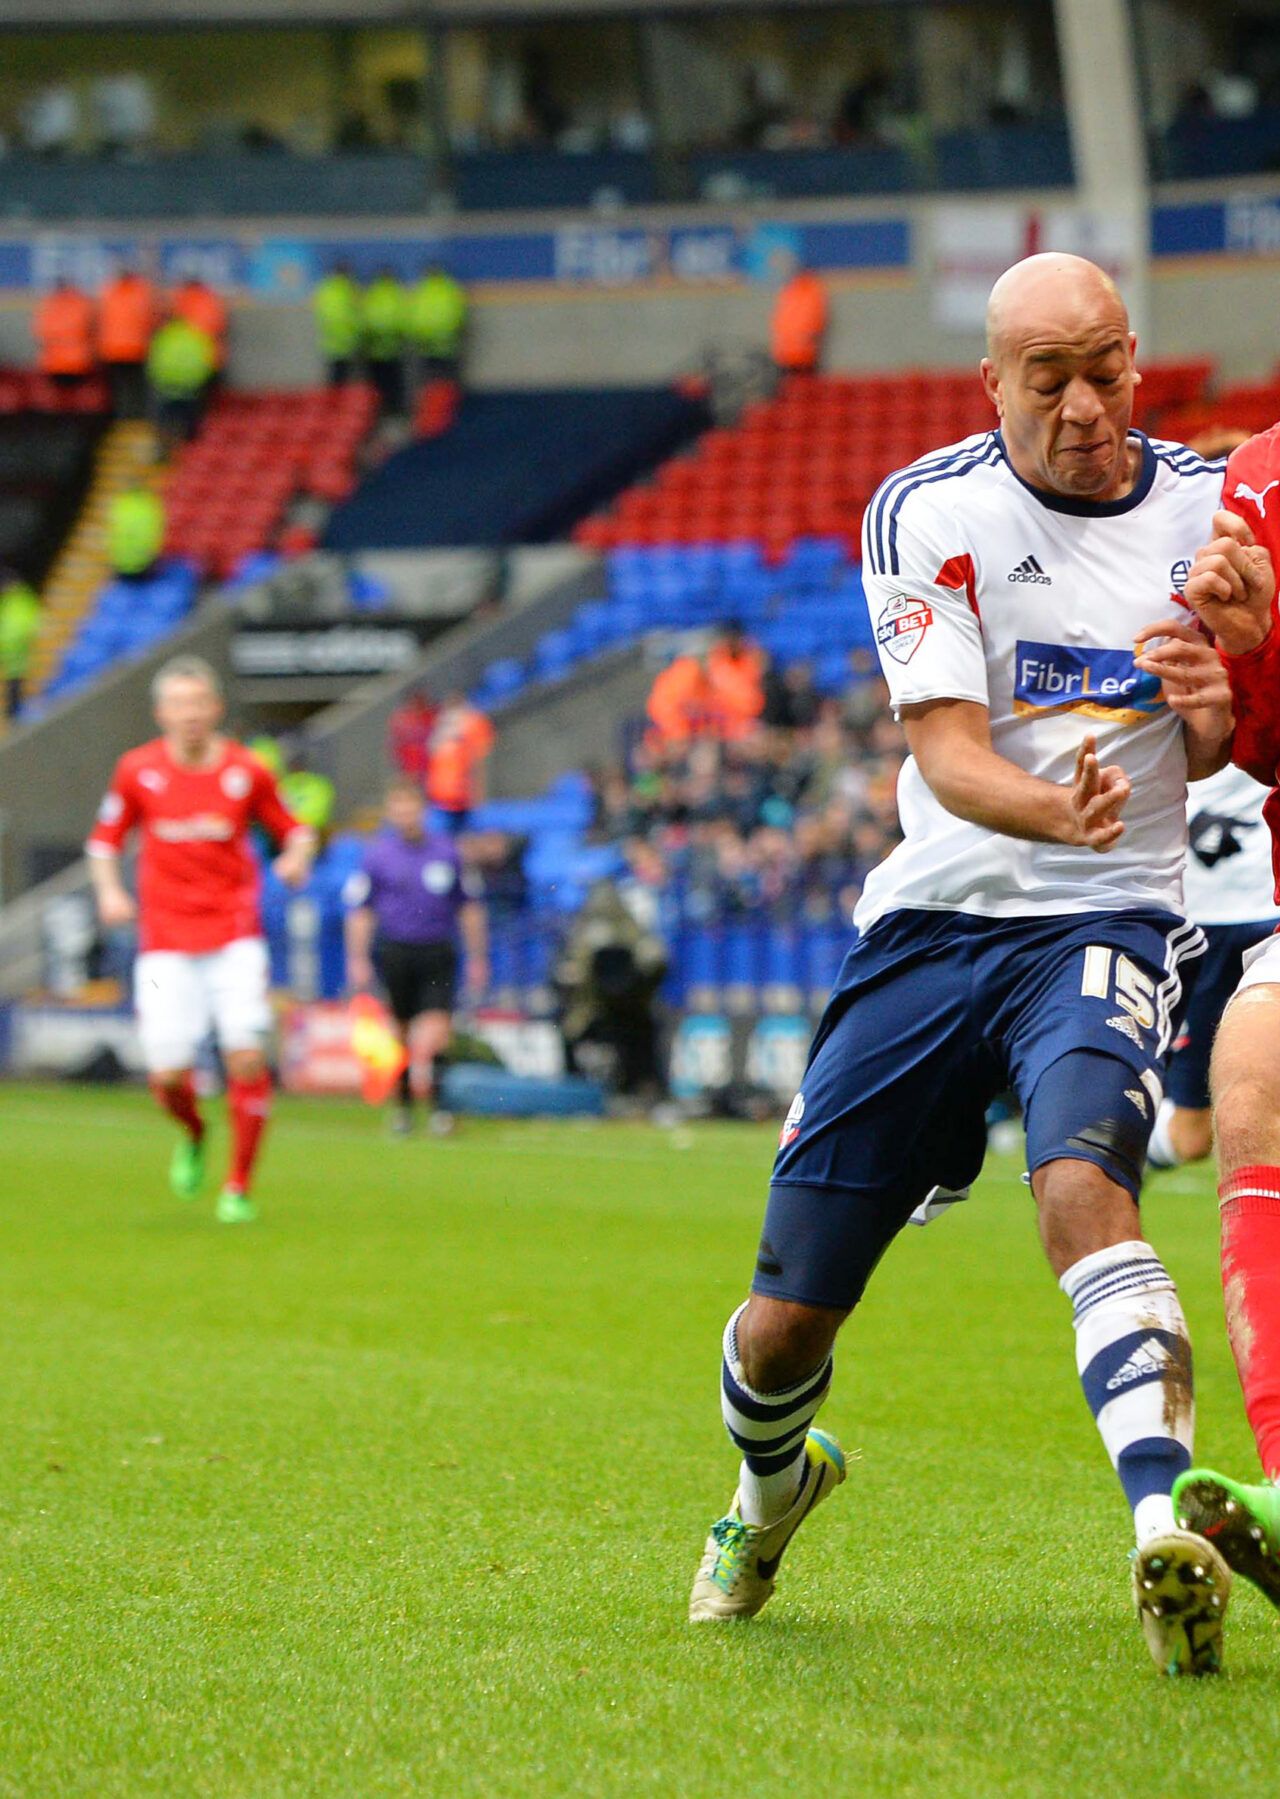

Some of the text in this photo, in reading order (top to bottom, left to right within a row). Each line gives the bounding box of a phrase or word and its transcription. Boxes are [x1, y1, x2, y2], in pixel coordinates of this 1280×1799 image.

[1008, 572, 1052, 586] adidas
[898, 610, 930, 632] BET
[1021, 659, 1137, 696] FibrLec
[1081, 946, 1155, 1029] 15
